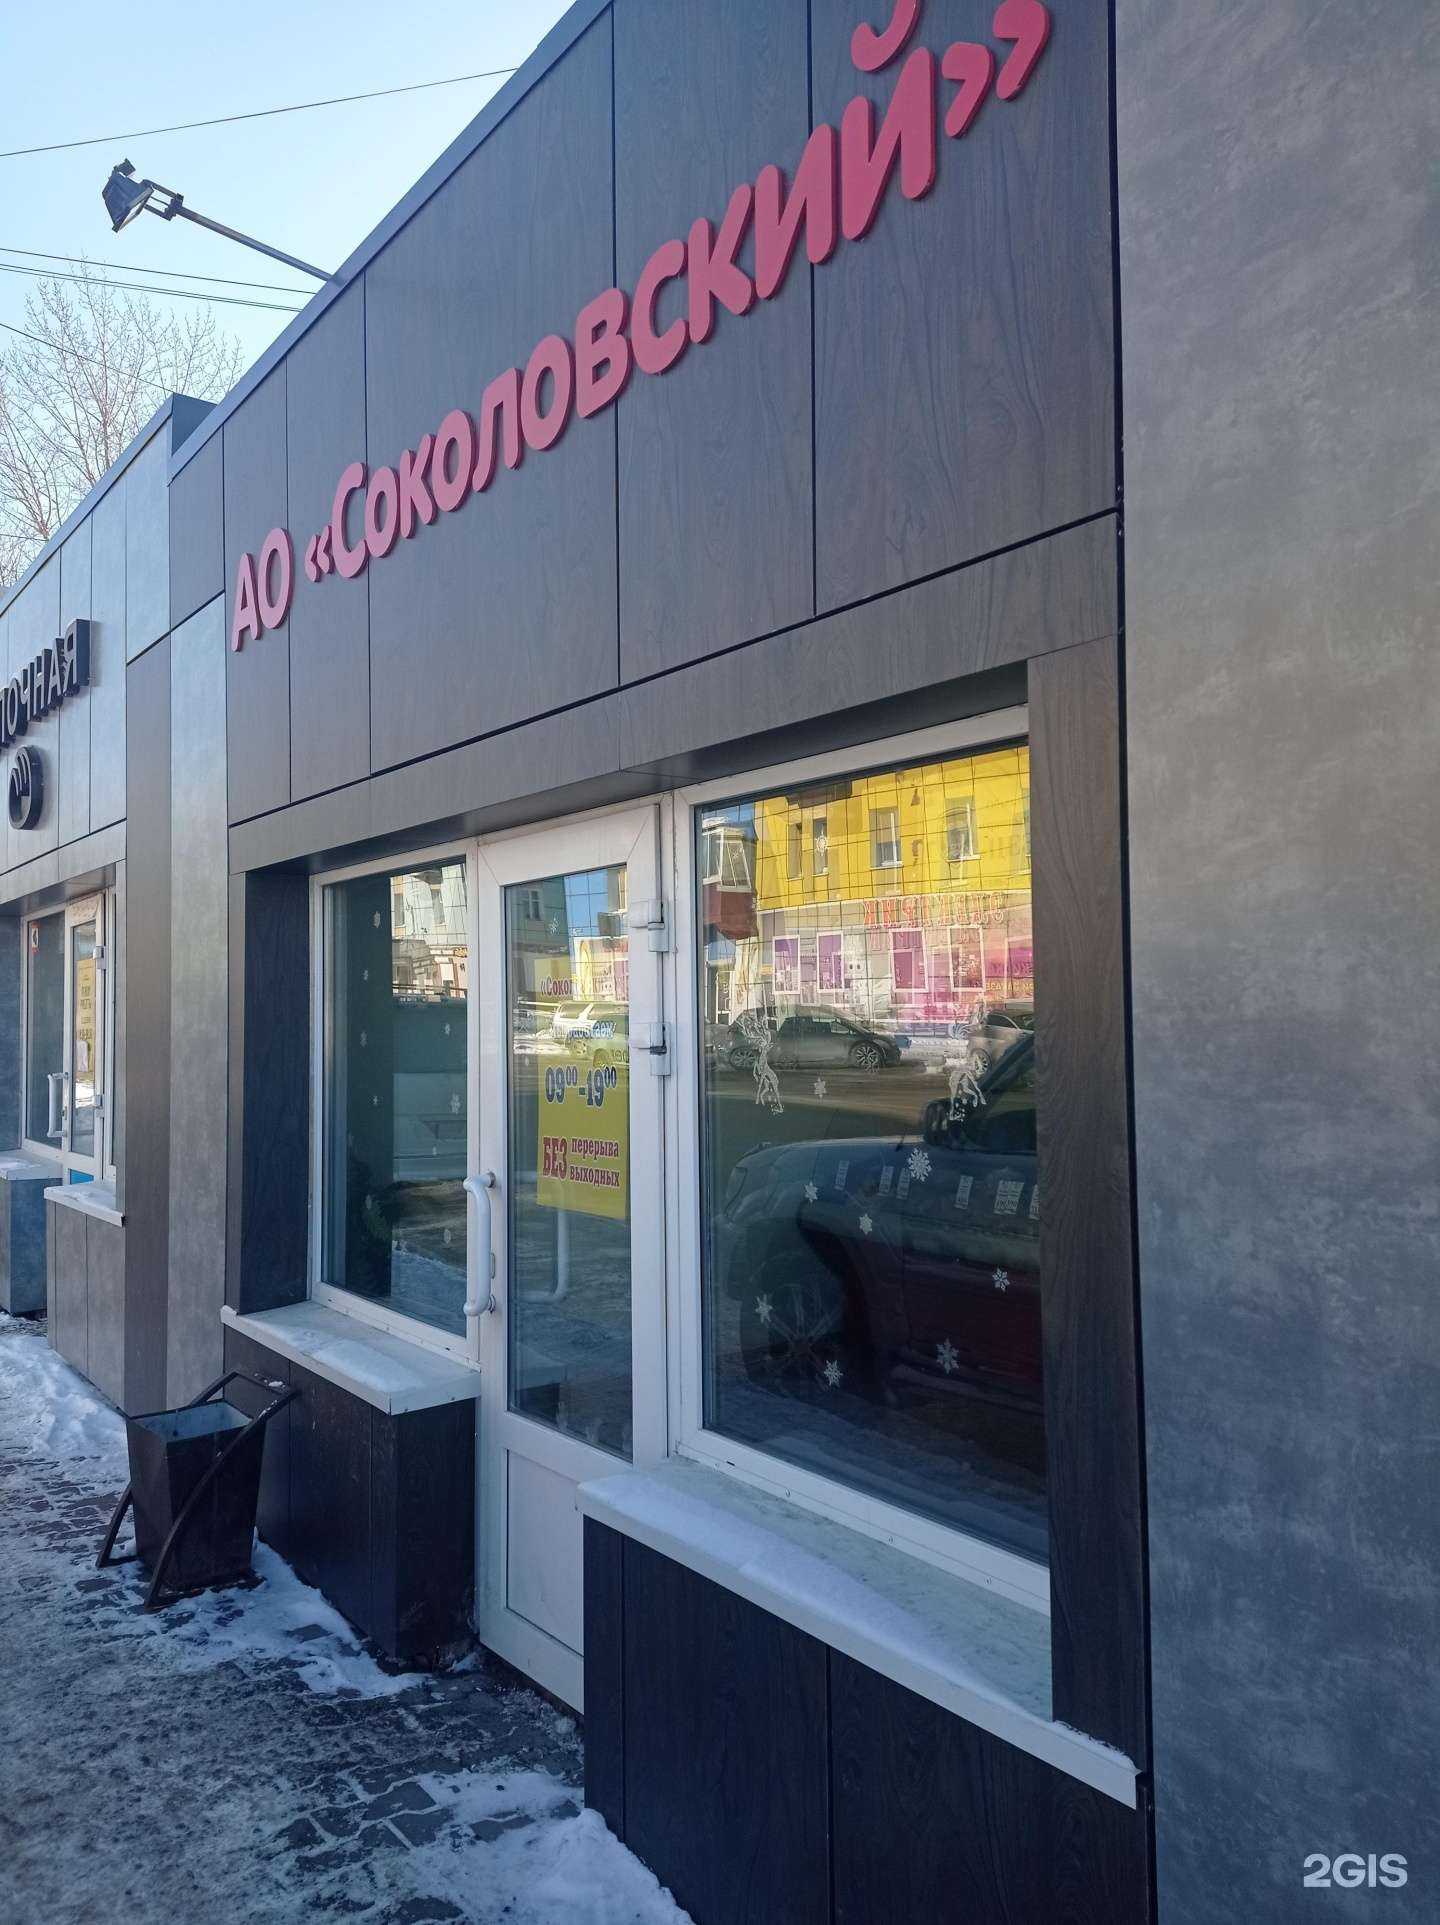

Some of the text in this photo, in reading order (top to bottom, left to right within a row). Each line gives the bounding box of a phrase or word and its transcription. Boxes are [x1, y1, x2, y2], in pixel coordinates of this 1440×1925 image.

[231, 527, 294, 653] АО
[542, 1136, 620, 1179] БЕЗ перерыва
[569, 1165, 620, 1187] выходных
